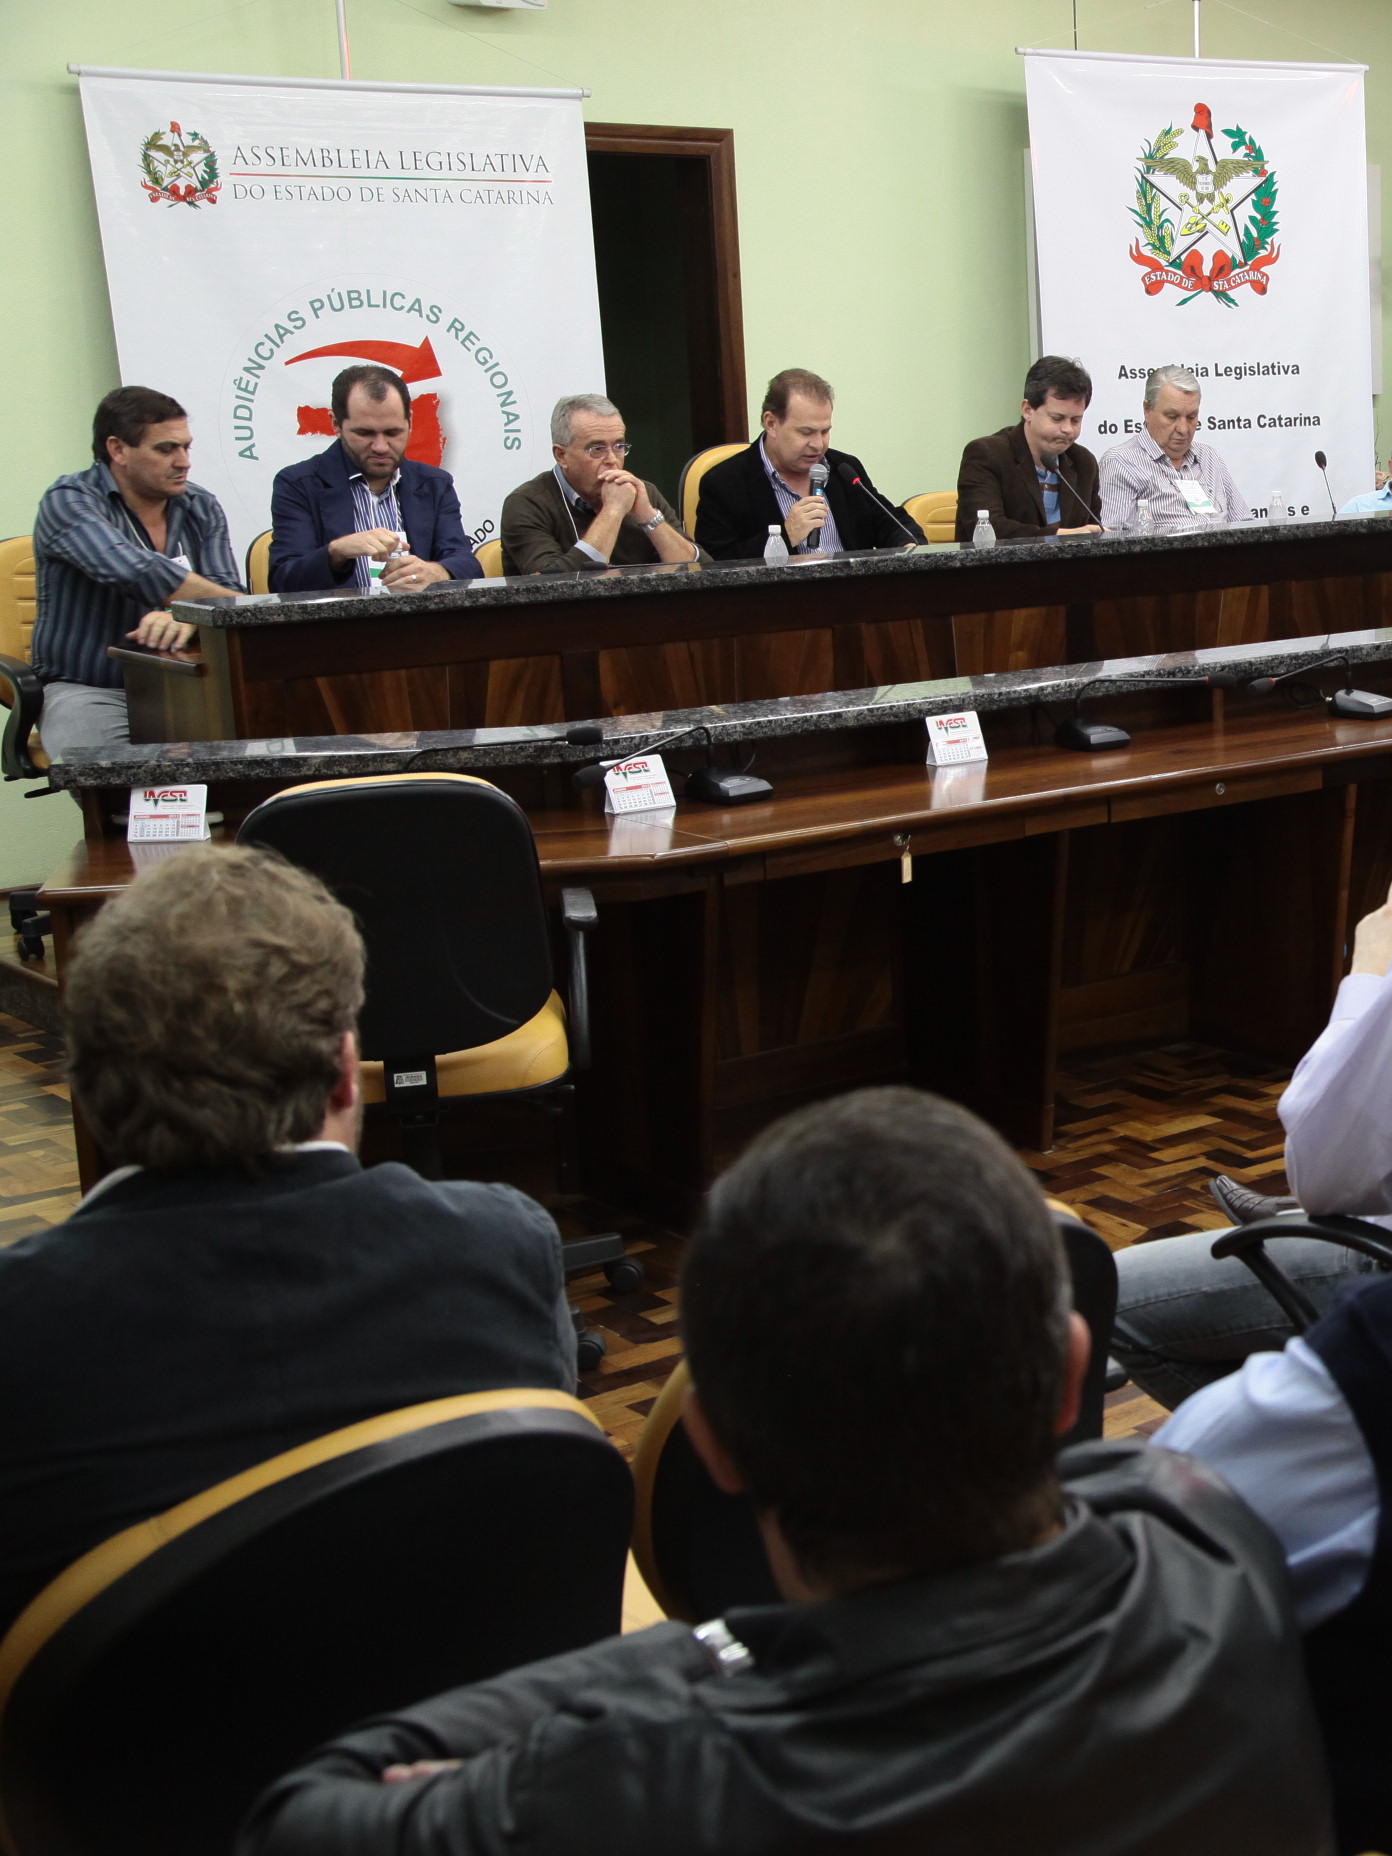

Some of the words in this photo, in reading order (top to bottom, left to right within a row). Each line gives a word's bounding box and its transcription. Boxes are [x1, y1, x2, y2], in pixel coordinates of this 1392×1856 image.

[232, 145, 390, 170] ASSEMBLEIA
[399, 150, 551, 173] LEGISLATIVA
[233, 183, 265, 200] DO
[273, 184, 351, 202] ESTADO
[359, 186, 385, 203] DE
[392, 187, 454, 204] SANTA
[459, 188, 554, 205] CATARINA
[1144, 270, 1180, 284] ESTADO
[1181, 279, 1195, 290] DE
[232, 310, 307, 462] AUDIÊNCIAS
[309, 288, 443, 324] PÚBLICAS
[446, 317, 522, 451] REGIONAIS
[1118, 363, 1209, 379] Asseeia
[1214, 361, 1300, 380] Legislativa
[1098, 419, 1118, 434] do
[1207, 415, 1252, 431] Santa
[1256, 413, 1321, 429] Catarina
[1300, 504, 1310, 516] e
